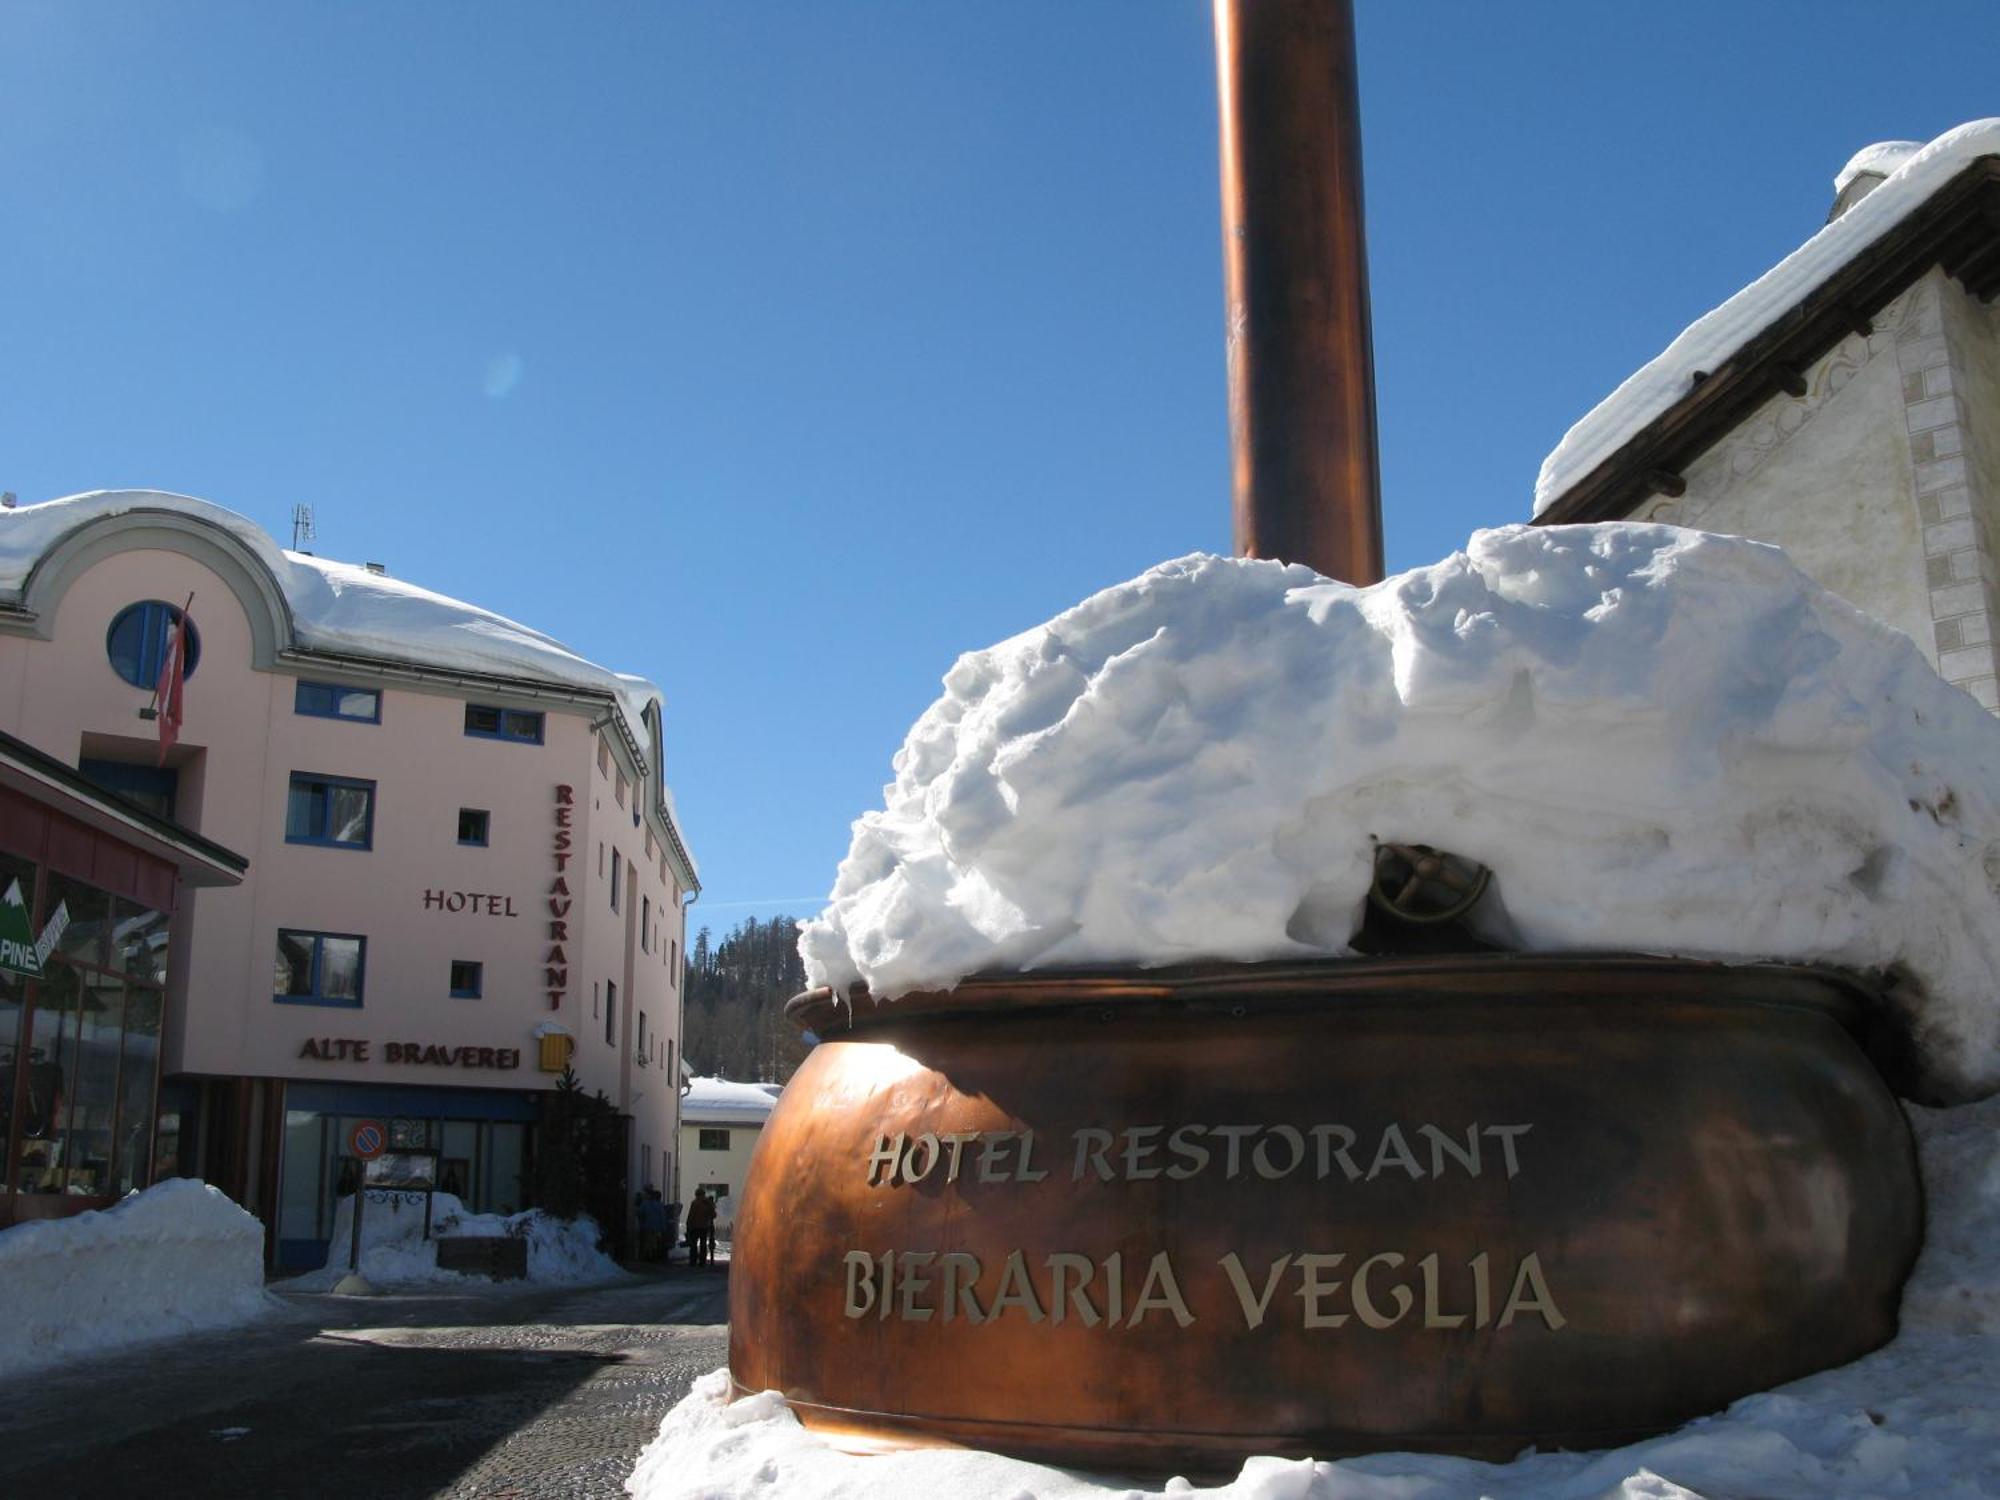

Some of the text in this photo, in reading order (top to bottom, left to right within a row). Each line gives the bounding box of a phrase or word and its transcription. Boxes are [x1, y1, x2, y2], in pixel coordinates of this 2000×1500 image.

[423, 889, 518, 917] HOTEL
[299, 1037, 370, 1062] ALTE
[866, 1122, 1534, 1188] HOTEL RESTORANT
[843, 1249, 1567, 1331] BIERARIA VEGLIA
